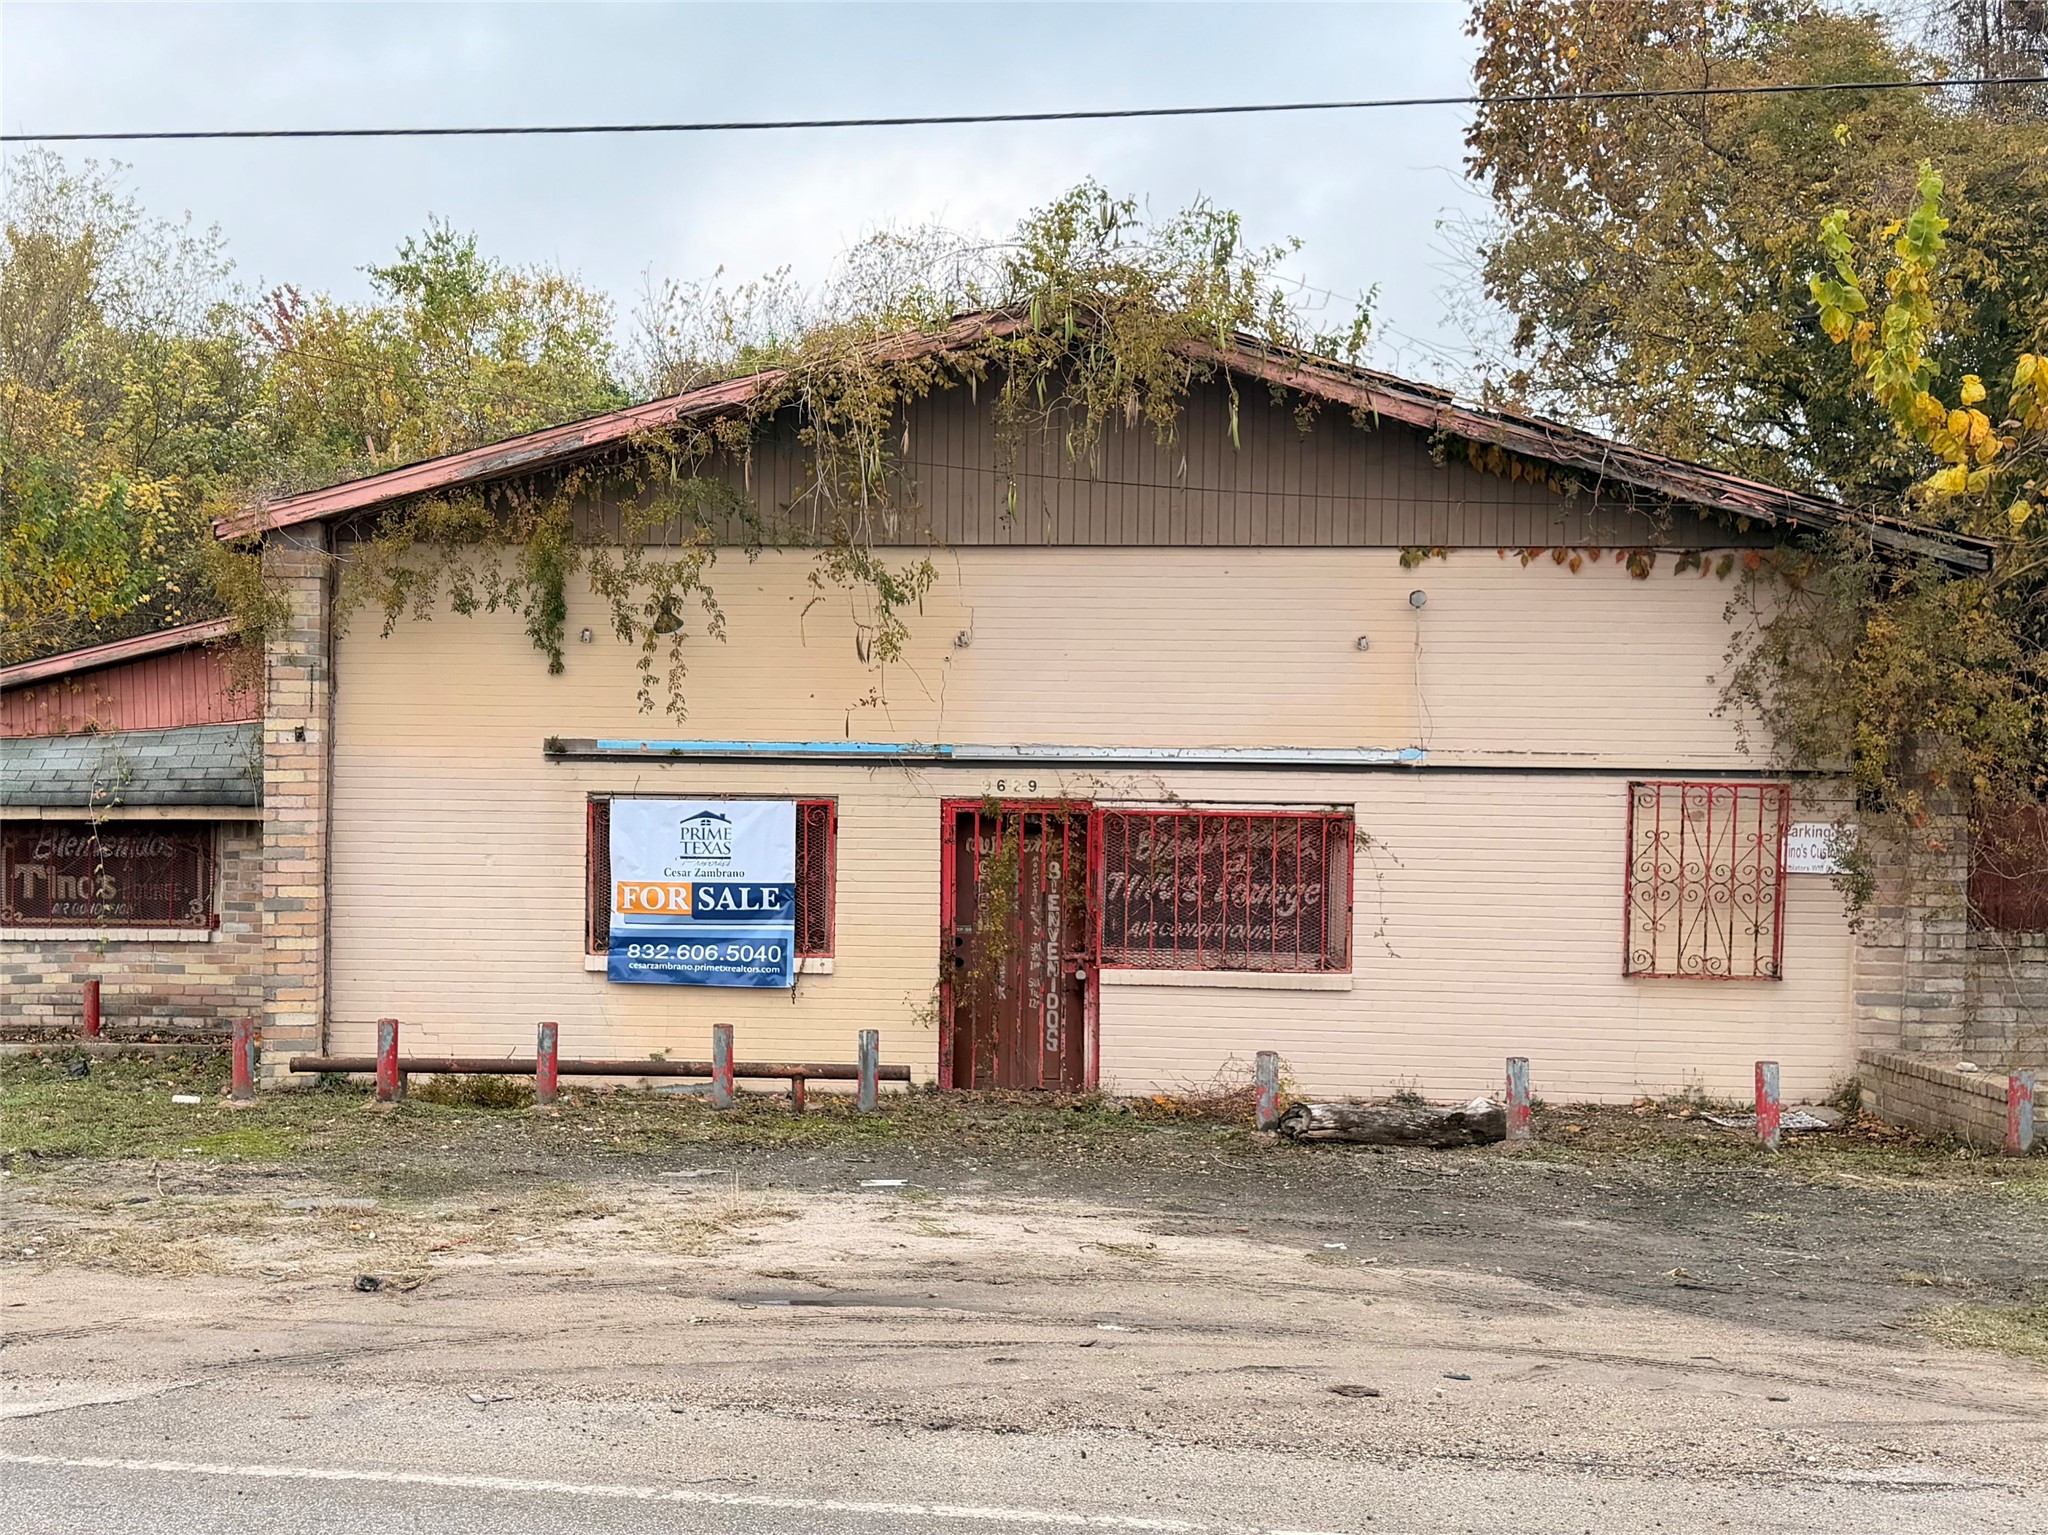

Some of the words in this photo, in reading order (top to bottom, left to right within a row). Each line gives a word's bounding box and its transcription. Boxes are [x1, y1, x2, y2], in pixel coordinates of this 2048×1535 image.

[680, 827, 732, 841] PRIME
[680, 841, 732, 855] TEXAS
[1788, 843, 1808, 859] ino's
[664, 867, 692, 877] Cesar
[694, 867, 745, 878] Zambrano
[621, 885, 690, 911] FOR
[698, 886, 781, 912] SALE
[1128, 920, 1159, 938] AIR
[627, 943, 782, 963] 832.606.5040
[628, 961, 781, 974] cesarzambrano.primetxrealtors.com
